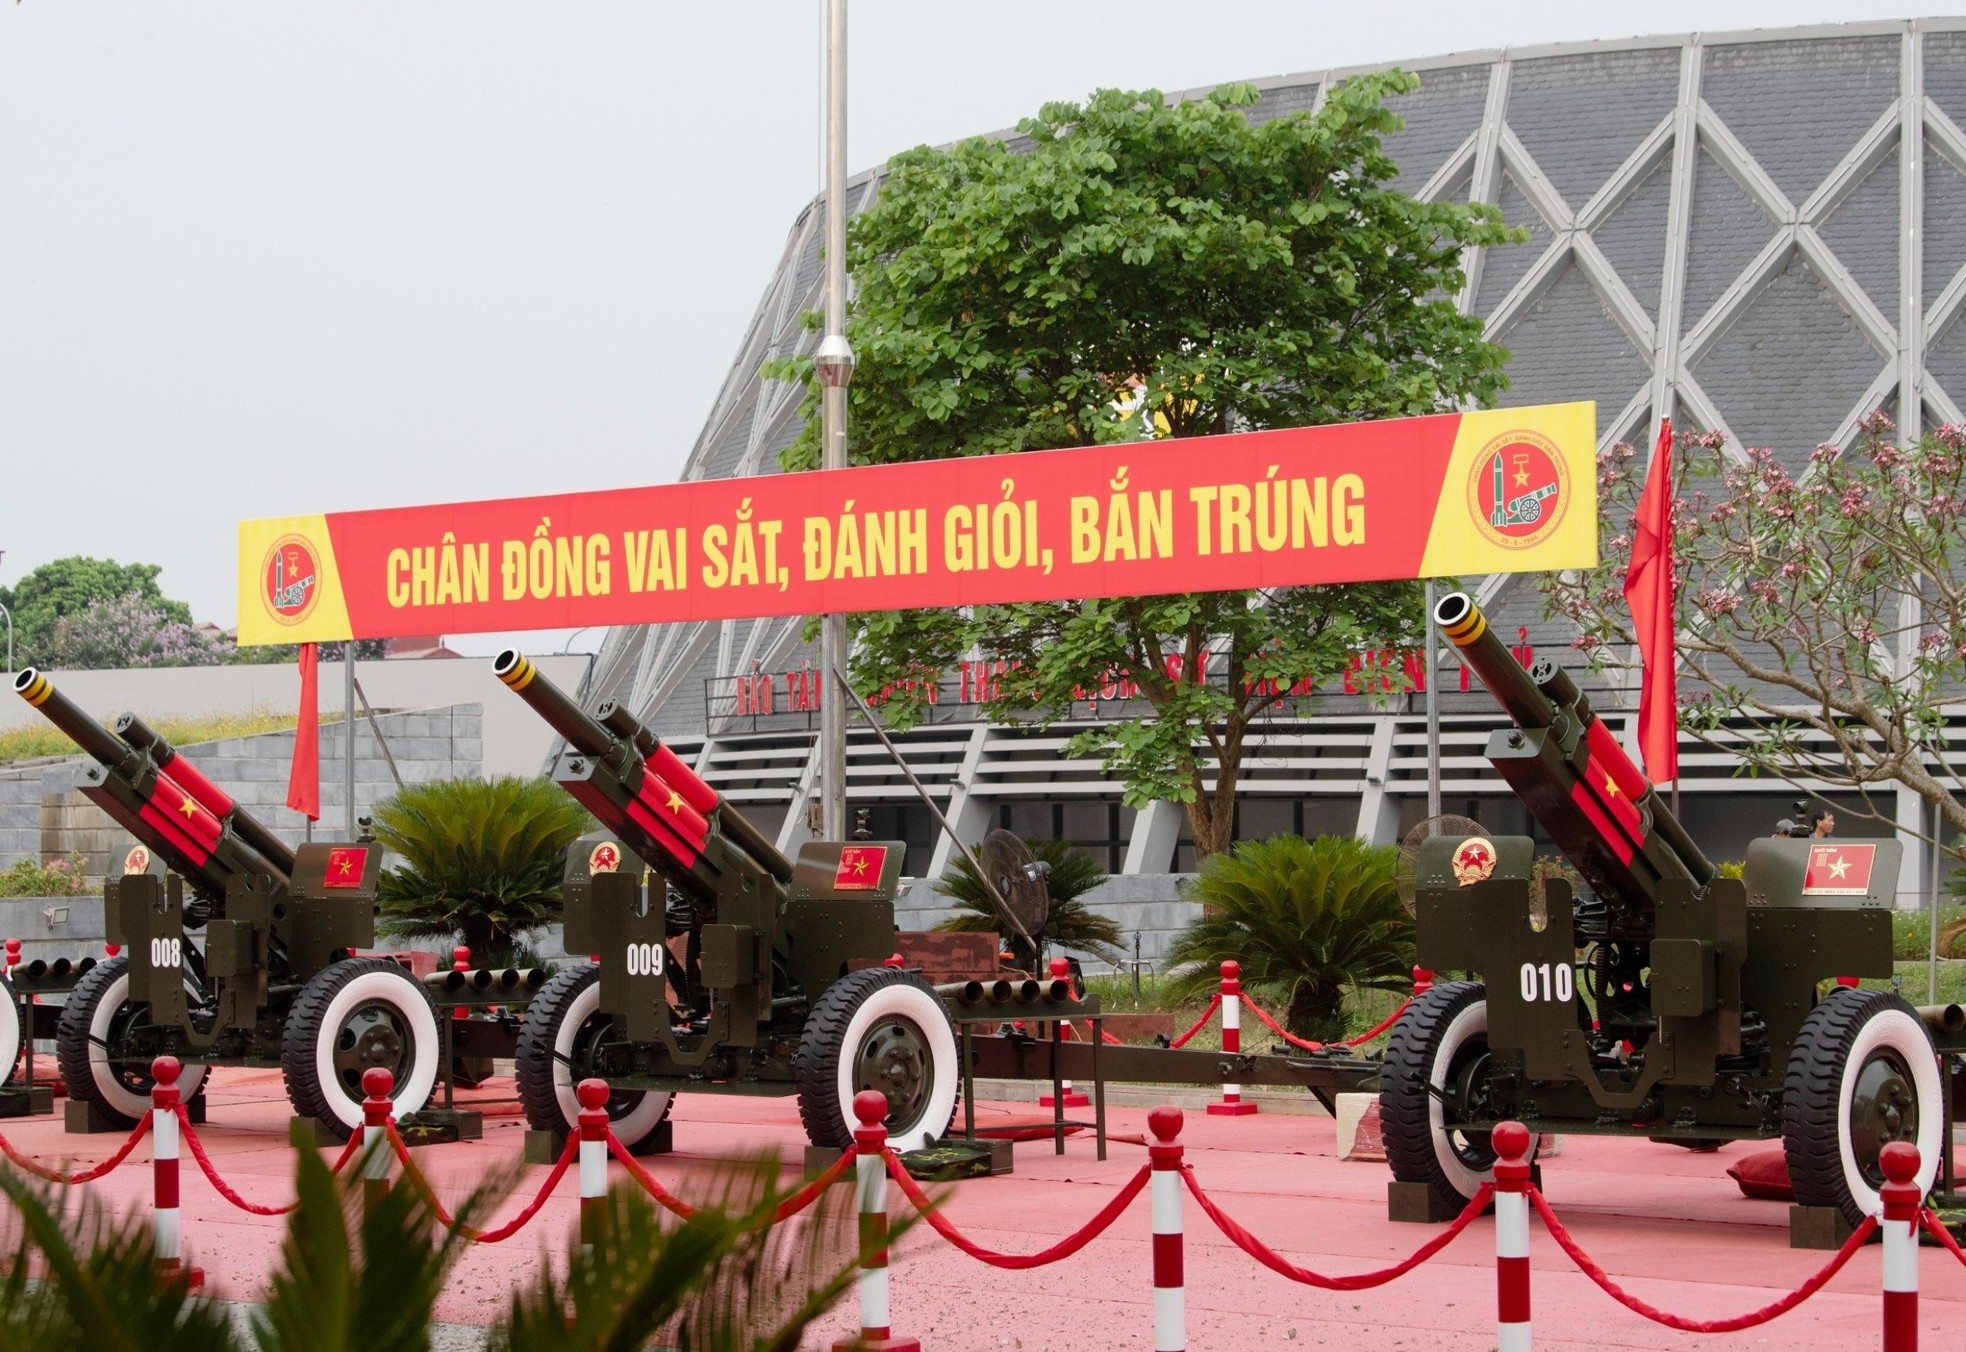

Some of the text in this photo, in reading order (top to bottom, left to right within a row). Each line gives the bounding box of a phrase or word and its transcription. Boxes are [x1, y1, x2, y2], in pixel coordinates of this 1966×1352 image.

[387, 531, 489, 608] CHÂN
[501, 516, 610, 600] ĐỒNG
[624, 527, 687, 594] VAI
[702, 497, 789, 592] SẮT,
[802, 500, 928, 582] ĐÁNH
[943, 478, 1054, 576] GIỎI,
[1071, 465, 1173, 565] BẮN
[1189, 464, 1366, 556] TRÚNG
[151, 937, 181, 968] 008
[627, 943, 663, 976] 009
[1520, 962, 1573, 1002] 010
